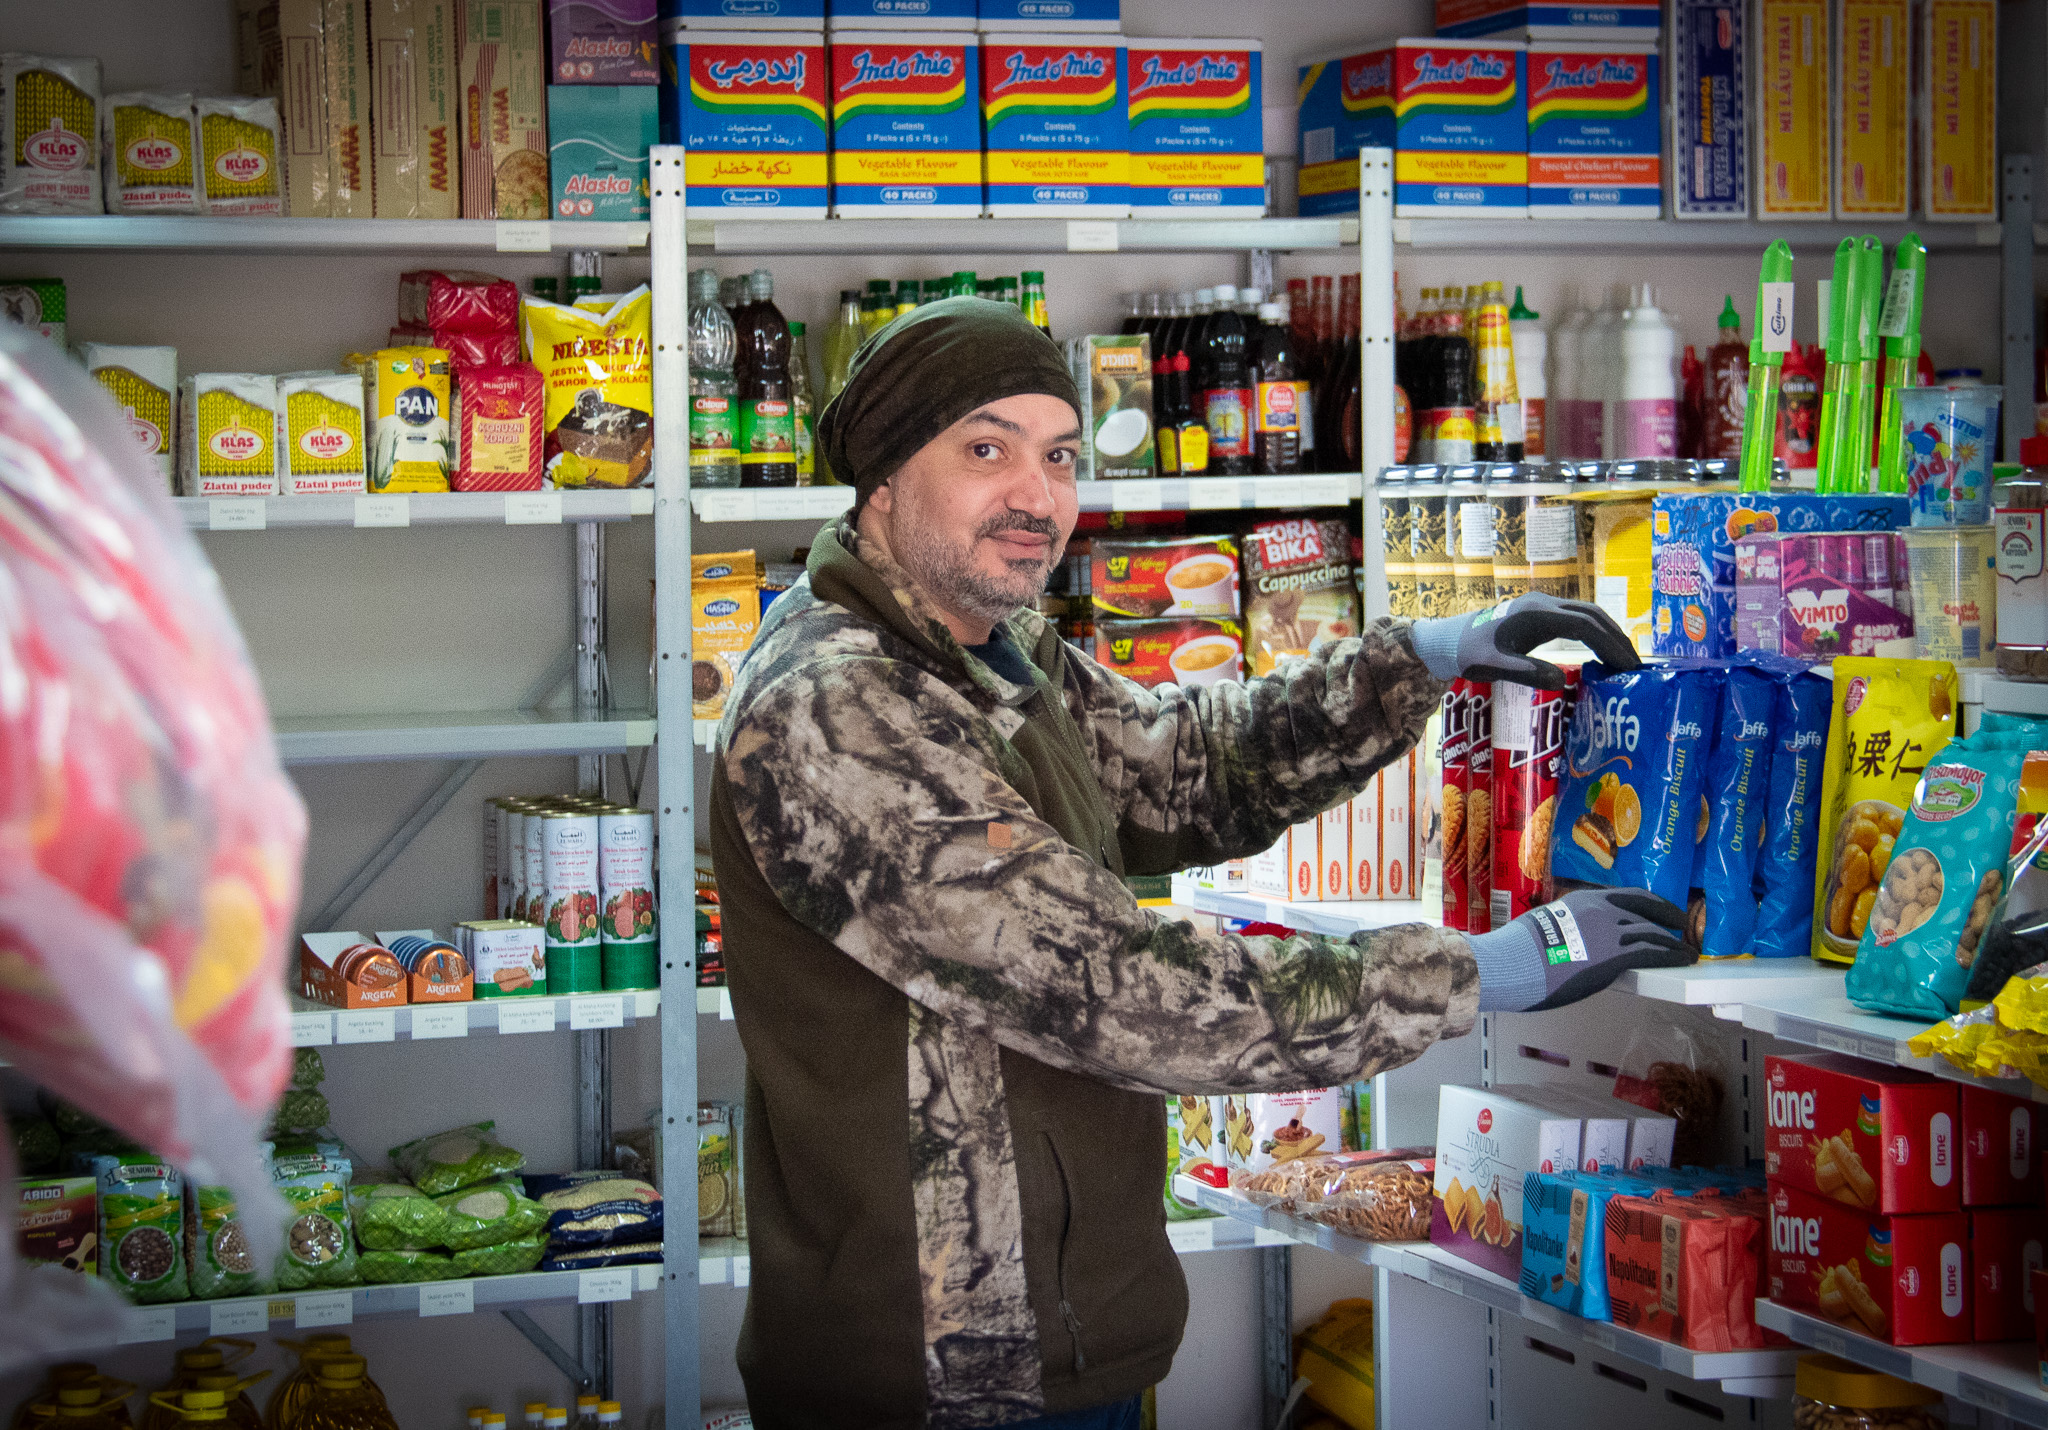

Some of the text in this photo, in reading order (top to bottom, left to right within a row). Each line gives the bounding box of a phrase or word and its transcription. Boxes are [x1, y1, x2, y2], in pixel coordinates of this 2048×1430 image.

[565, 37, 631, 58] Alaska
[39, 142, 77, 157] KLAS
[136, 147, 172, 160] KLAS
[428, 125, 448, 192] MAMA
[225, 158, 259, 171] KLAS
[711, 160, 792, 179] نكهة خضار
[858, 158, 958, 171] Vegetable Flavour
[1011, 158, 1109, 171] Vegetable Flavour
[1147, 161, 1242, 173] Vegetable Flavour
[1416, 159, 1509, 172] Vegetable Flavour
[1539, 161, 1572, 173] Special
[1614, 161, 1650, 172] Flavour
[565, 174, 631, 195] Alaska
[884, 191, 933, 200] 40 PACKS
[1037, 191, 1086, 200] 40 PACKS
[1172, 192, 1219, 202] 40 PACKS
[553, 378, 587, 388] SKROB
[220, 436, 255, 448] KLAS
[310, 435, 344, 448] KLAS
[203, 481, 273, 492] Zlatni puder
[294, 479, 363, 490] Zlatni puder
[1265, 519, 1318, 541] TORA
[1265, 540, 1320, 565] BIKA
[1661, 542, 1700, 569] Bubble
[1258, 563, 1350, 594] Cappuccino
[1659, 568, 1701, 594] Bubbles
[1853, 624, 1900, 638] CANDY
[1578, 695, 1641, 768] Jaffa
[1670, 719, 1702, 739] Jaffa
[1738, 719, 1768, 739] Jaffa
[1793, 730, 1823, 749] Jaffa
[1443, 743, 1468, 762] choco
[1660, 747, 1687, 855] Orange Biscuit
[1730, 747, 1755, 852] Orange Biscuit
[1787, 758, 1808, 862] Orange Biscuit
[360, 991, 397, 1003] ARGETA
[425, 983, 462, 995] ARGETA
[1766, 1079, 1816, 1130] lane
[1465, 1129, 1500, 1160] STRUDLA
[1778, 1134, 1803, 1148] BISCUITS
[1934, 1133, 1947, 1167] lane
[22, 1187, 61, 1201] ABIDO
[34, 1208, 72, 1225] Powder
[1769, 1203, 1820, 1257] lane
[1525, 1225, 1563, 1260] Napolitanke
[1609, 1253, 1656, 1289] Napolitanke
[1781, 1258, 1807, 1274] BISCUITS
[1946, 1263, 1958, 1298] lane
